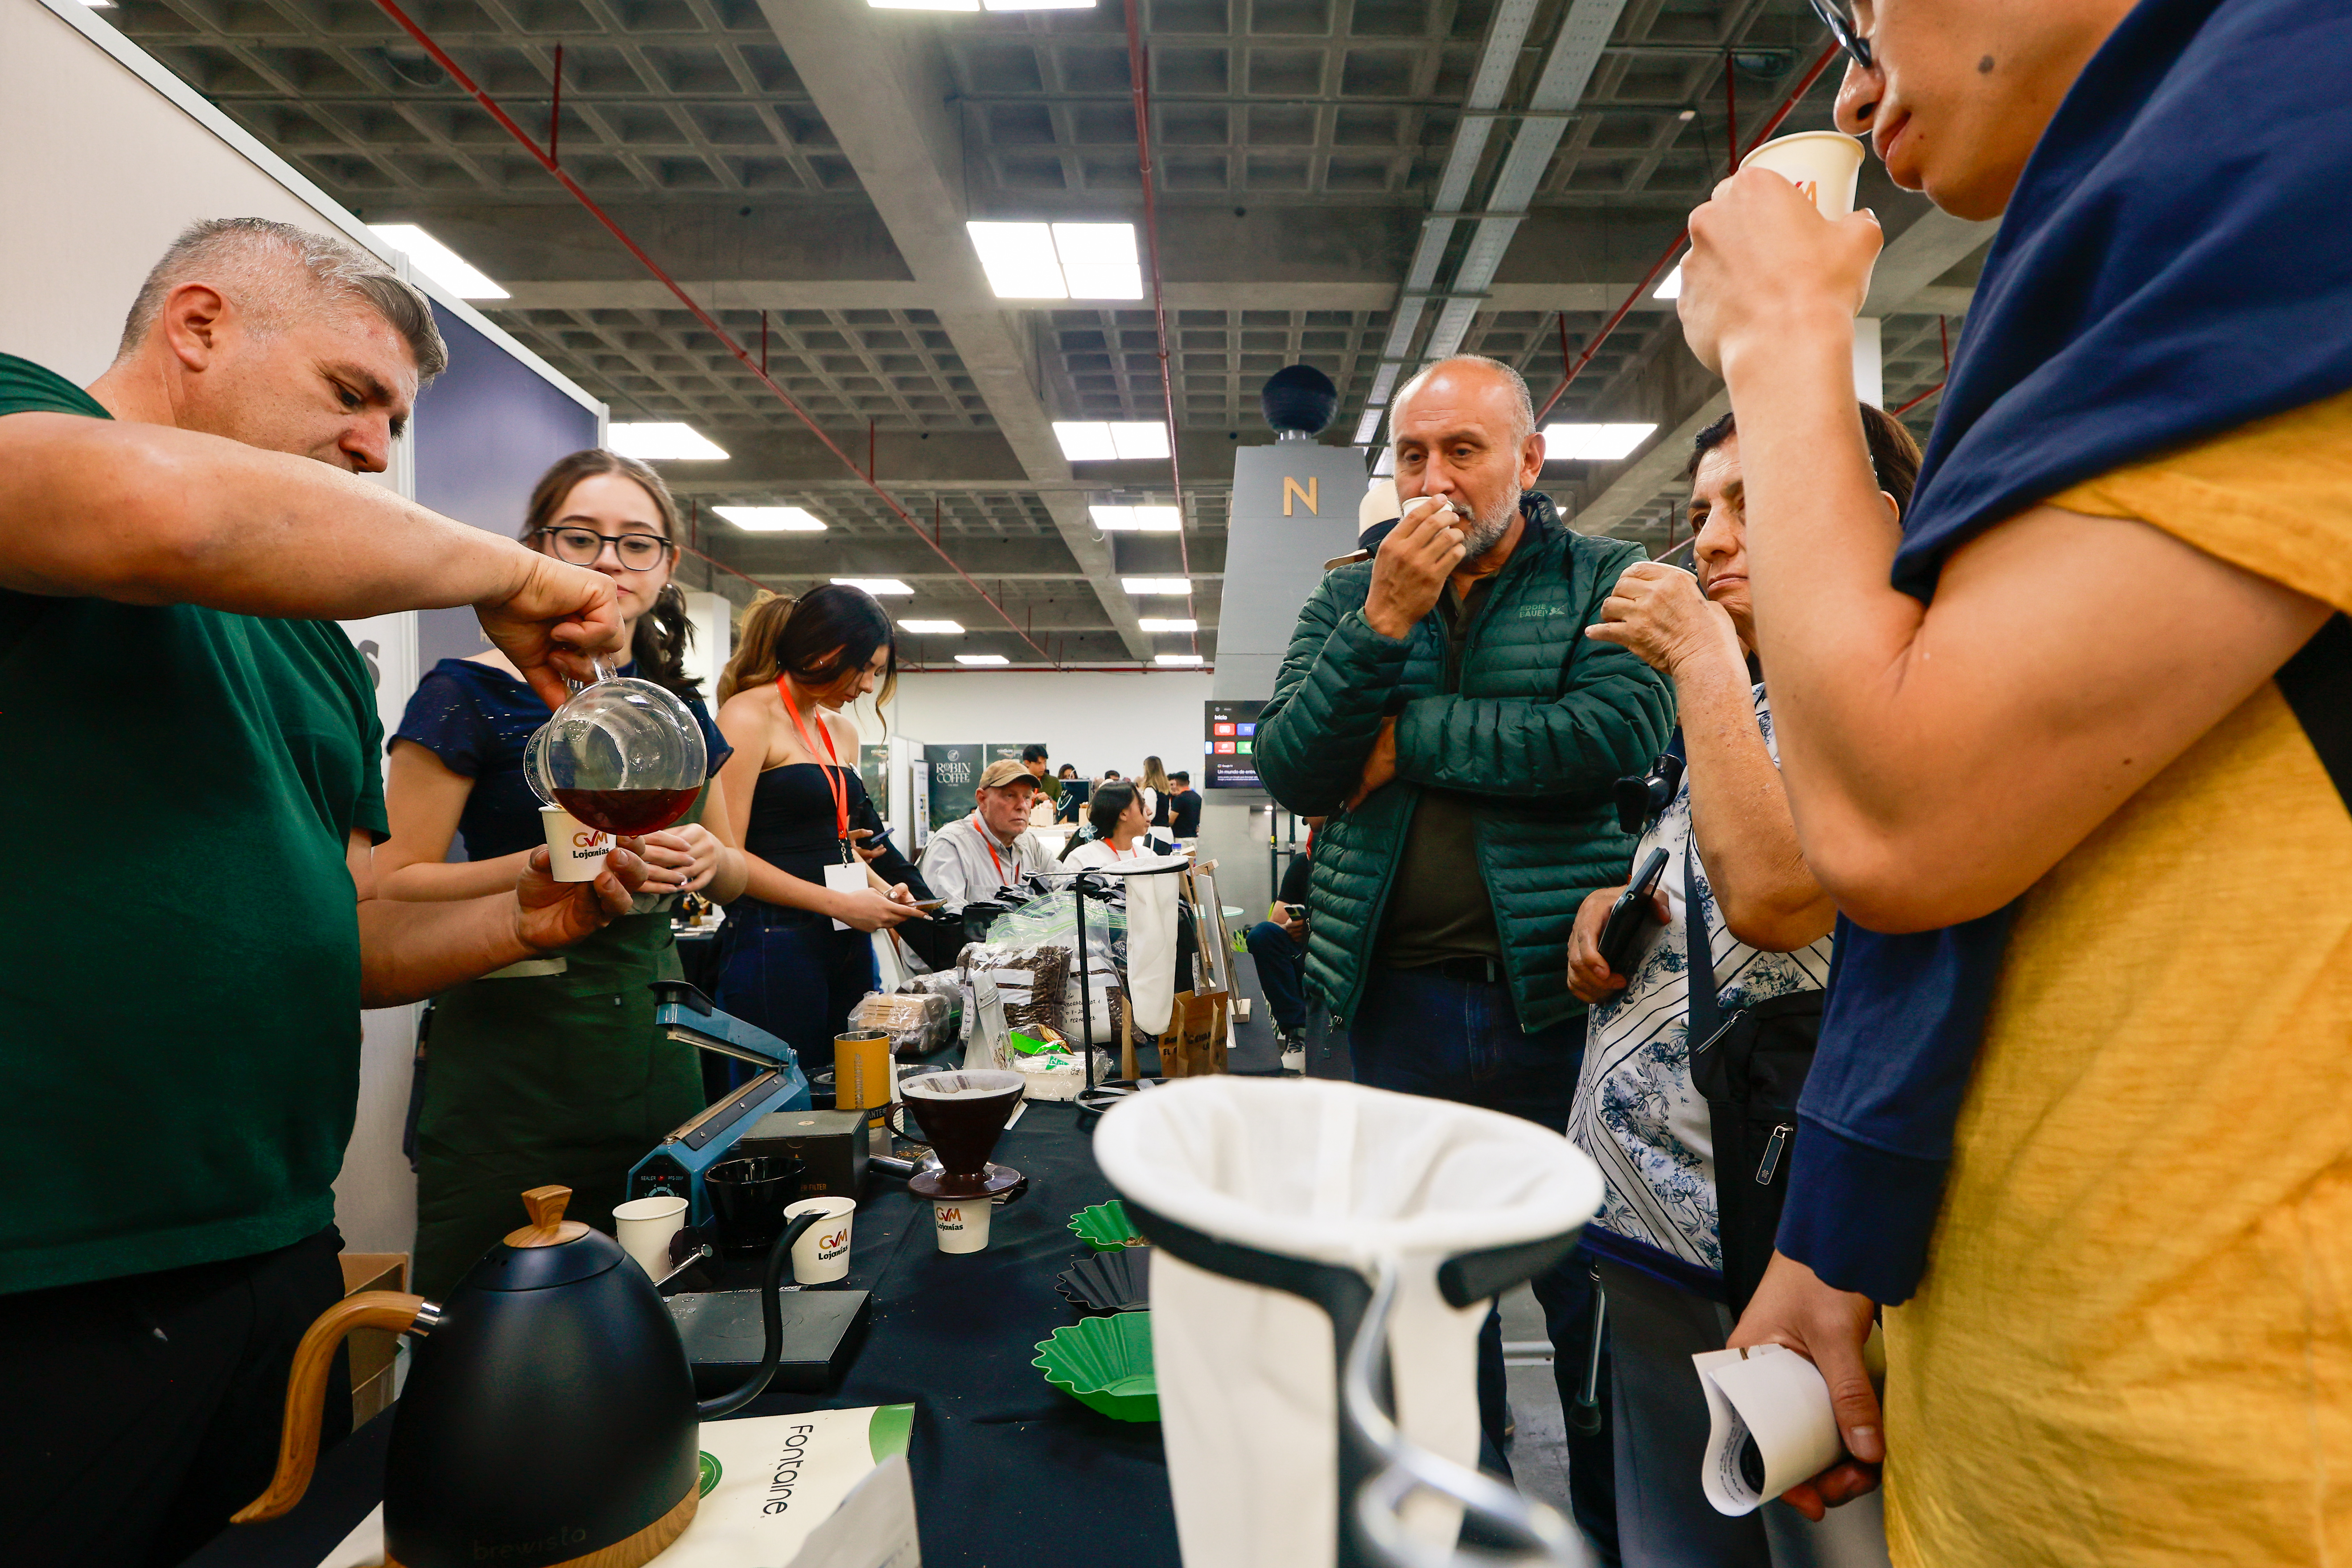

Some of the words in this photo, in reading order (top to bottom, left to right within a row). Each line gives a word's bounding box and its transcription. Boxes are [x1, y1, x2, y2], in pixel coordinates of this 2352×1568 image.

[1283, 476, 1317, 516] N
[936, 762, 971, 773] ROBIN
[936, 773, 970, 783] COFFEE
[573, 847, 610, 859] Lojanías
[937, 1221, 964, 1231] Lojanías
[818, 1245, 848, 1260] Lojanías
